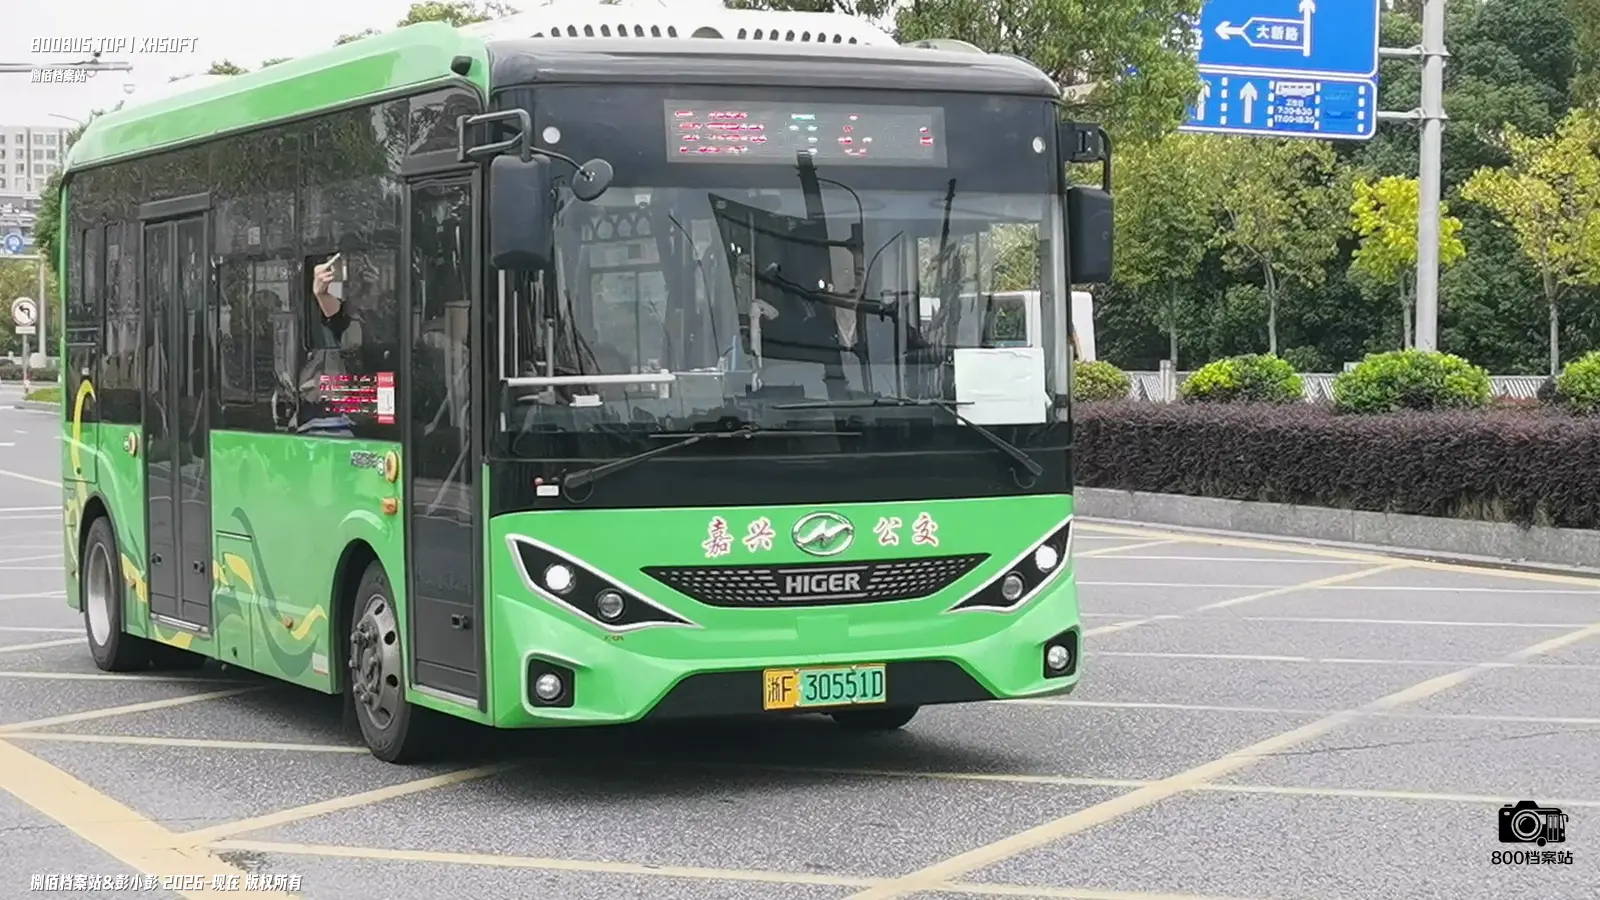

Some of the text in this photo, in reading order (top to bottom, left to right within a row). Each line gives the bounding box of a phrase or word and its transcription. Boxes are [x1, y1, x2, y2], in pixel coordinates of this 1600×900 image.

[1256, 25, 1299, 41] 大新路
[702, 512, 940, 558] 嘉兴 公交
[785, 573, 861, 594] HIGER
[805, 670, 884, 701] 30551D
